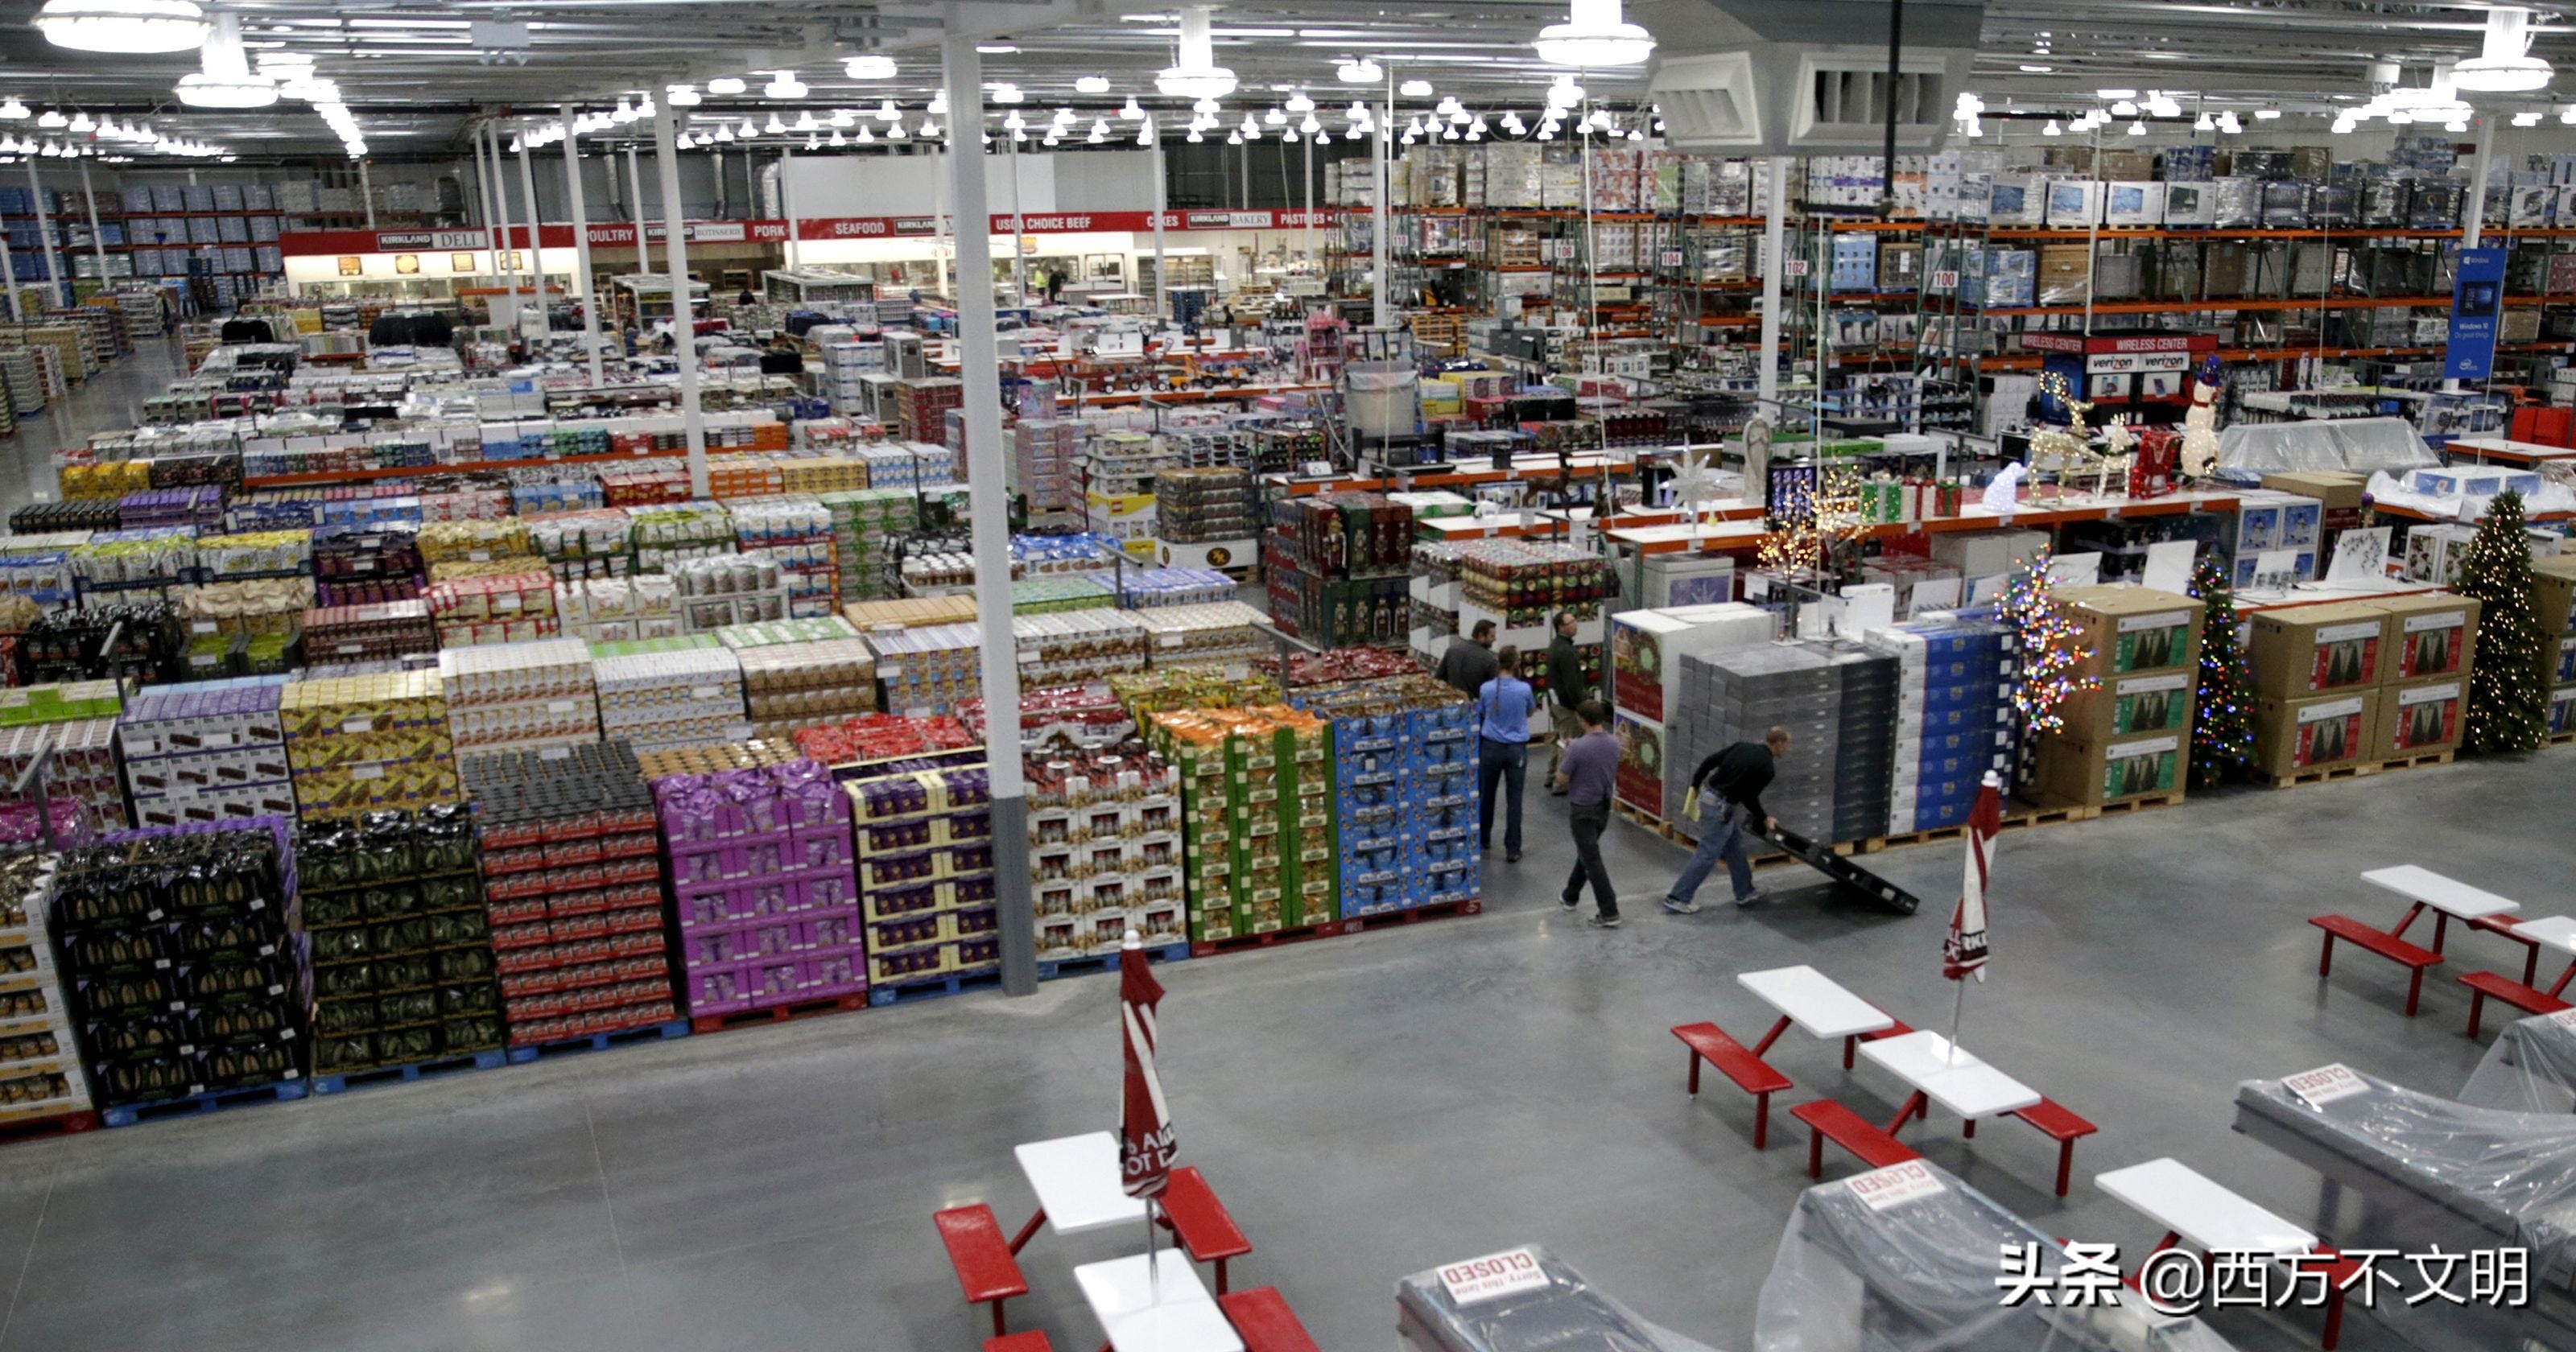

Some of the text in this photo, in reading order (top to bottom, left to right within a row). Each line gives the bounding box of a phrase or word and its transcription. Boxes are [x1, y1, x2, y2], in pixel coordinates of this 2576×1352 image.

[897, 220, 937, 229] KIRKLAN
[1026, 217, 1065, 230] CHOICE
[1067, 216, 1092, 229] BEEF
[1146, 215, 1179, 228] CKES
[1190, 214, 1269, 225] KIRKLAND BAKERY
[1280, 213, 1325, 225] PASTES
[753, 225, 786, 237] PORK
[835, 221, 886, 235] SEAFOOD
[381, 233, 477, 247] KIRKLAND DELI
[586, 229, 634, 242] OULTRY
[1557, 245, 1572, 258] 106
[1662, 253, 1679, 266] 104
[1787, 262, 1805, 274] 102
[1935, 273, 1955, 286] 100
[2021, 334, 2083, 352] WIRELESS CENTER
[2116, 338, 2188, 351] WIRELESS CENTER
[2094, 356, 2132, 370] verizon
[2145, 354, 2183, 369] verizon
[2288, 1068, 2348, 1090] CLOSED
[1852, 1164, 1926, 1194] CLOSED
[1444, 1252, 1534, 1285] CLOSED
